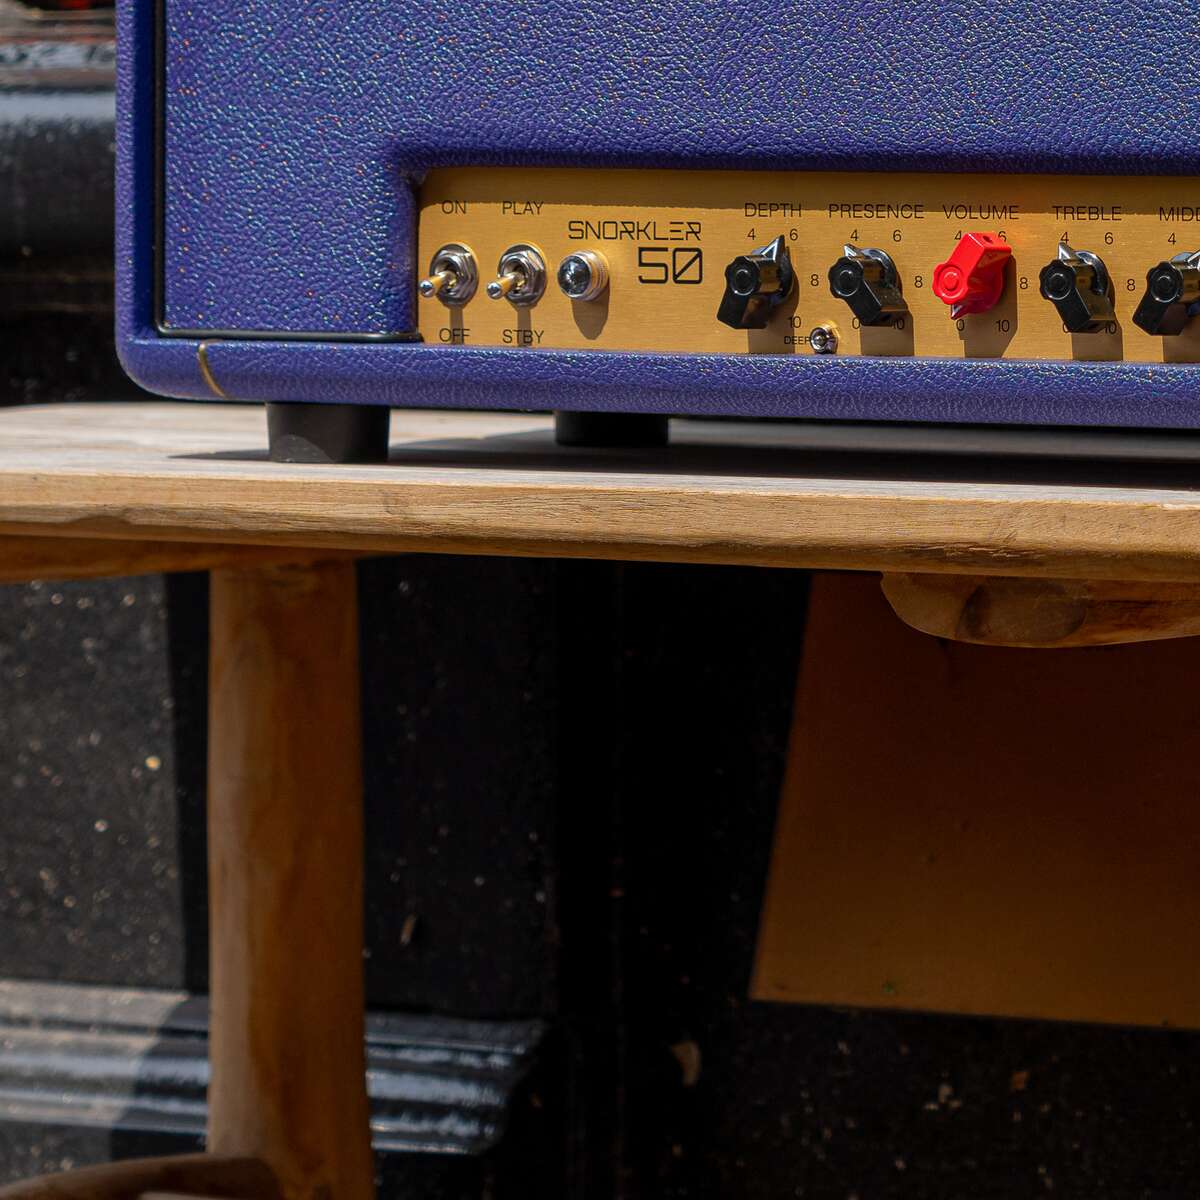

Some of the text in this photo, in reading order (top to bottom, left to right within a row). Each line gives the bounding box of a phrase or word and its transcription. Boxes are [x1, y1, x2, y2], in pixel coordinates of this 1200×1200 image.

[441, 201, 467, 215] ON
[502, 201, 544, 216] PLAY
[744, 203, 802, 218] DEPTH
[828, 204, 925, 219] PRESENCE
[942, 205, 1019, 220] VOLUME
[1052, 206, 1122, 221] TREBLE
[568, 220, 702, 241] SNORKLER
[747, 228, 757, 241] 4
[789, 229, 799, 241] 6
[850, 229, 859, 241] 4
[892, 230, 902, 242] 6
[1060, 232, 1069, 244] 4
[1104, 232, 1114, 245] 6
[1167, 233, 1177, 245] 4
[637, 247, 703, 285] 50
[810, 274, 819, 287] 8
[914, 275, 923, 288] 8
[1019, 276, 1029, 289] 8
[1126, 278, 1136, 291] 8
[789, 316, 802, 329] 10
[851, 317, 861, 329] 0
[956, 319, 965, 331] 0
[995, 319, 1010, 332] 10
[439, 328, 471, 343] OFF
[502, 329, 545, 344] STBY
